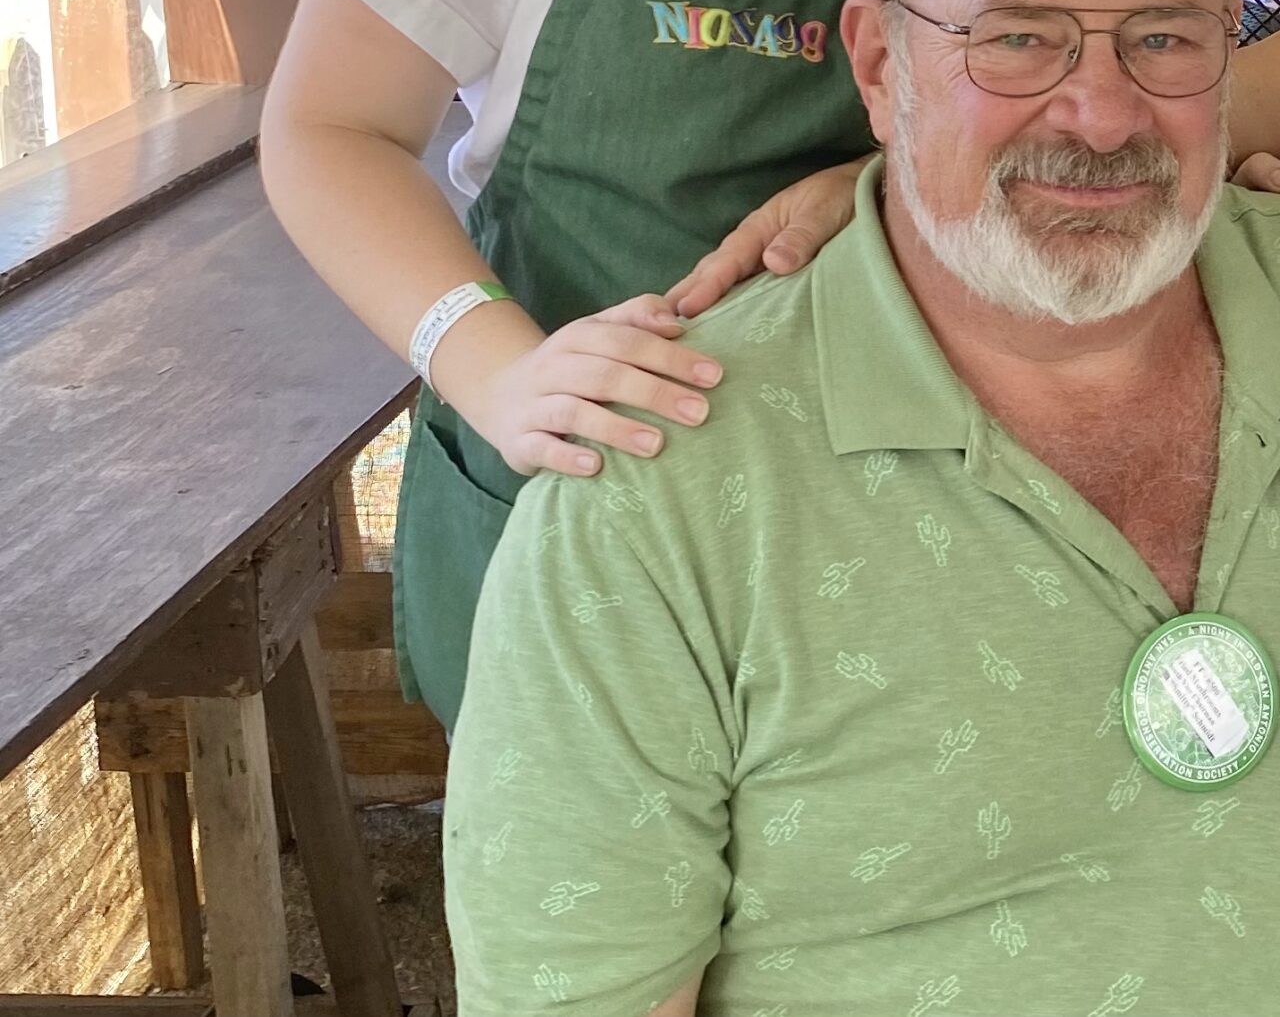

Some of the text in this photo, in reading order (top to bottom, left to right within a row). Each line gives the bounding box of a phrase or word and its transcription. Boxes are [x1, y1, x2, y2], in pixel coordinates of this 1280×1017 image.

[1200, 625, 1232, 642] NIGHT
[1233, 637, 1247, 650] IN
[1154, 634, 1175, 655] SAN
[1245, 650, 1262, 671] OLD
[1136, 652, 1156, 706] ANTONIO
[1258, 671, 1271, 696] SAN
[1249, 701, 1272, 754] ANTONIO
[1137, 709, 1194, 779] CONSERVATION
[1196, 760, 1240, 781] SOCIETY
